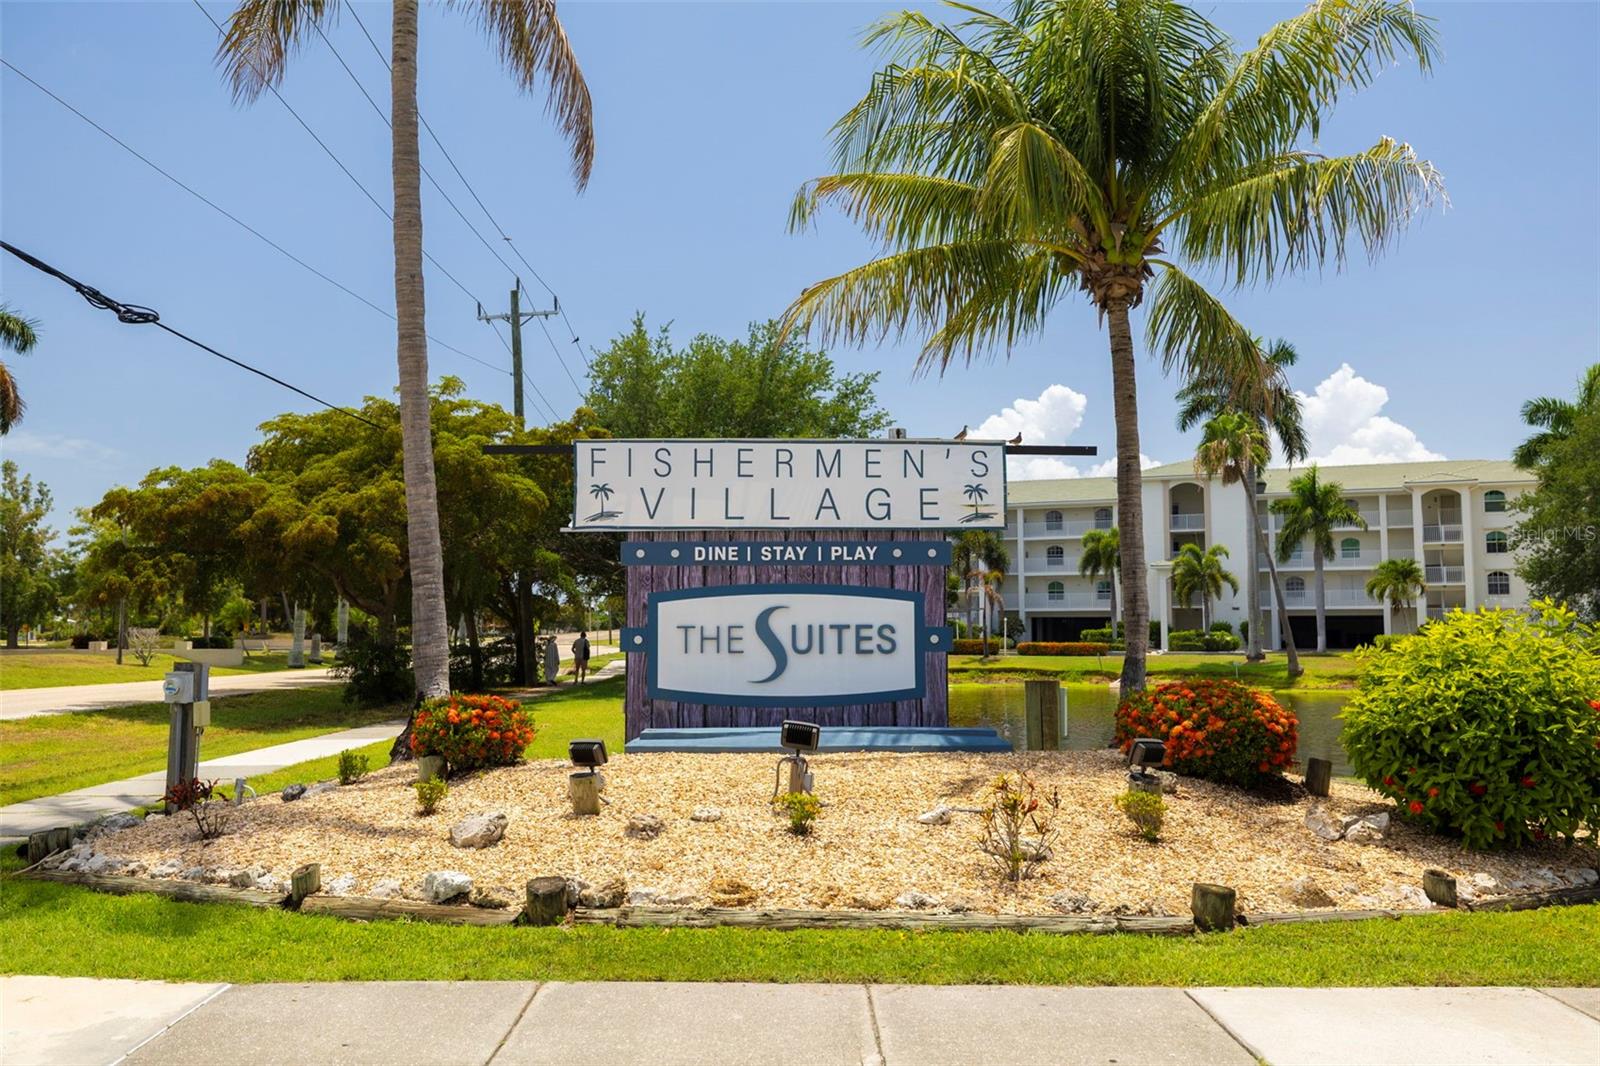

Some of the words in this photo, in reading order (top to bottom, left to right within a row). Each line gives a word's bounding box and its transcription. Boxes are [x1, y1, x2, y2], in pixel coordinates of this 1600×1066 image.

[590, 448, 989, 478] FISHERMEN'S
[640, 487, 940, 520] VILLAGE
[694, 547, 739, 561] DINE
[760, 547, 807, 561] STAY
[830, 547, 878, 561] PLAY
[676, 625, 745, 654] THE
[747, 605, 897, 684] SUITES
